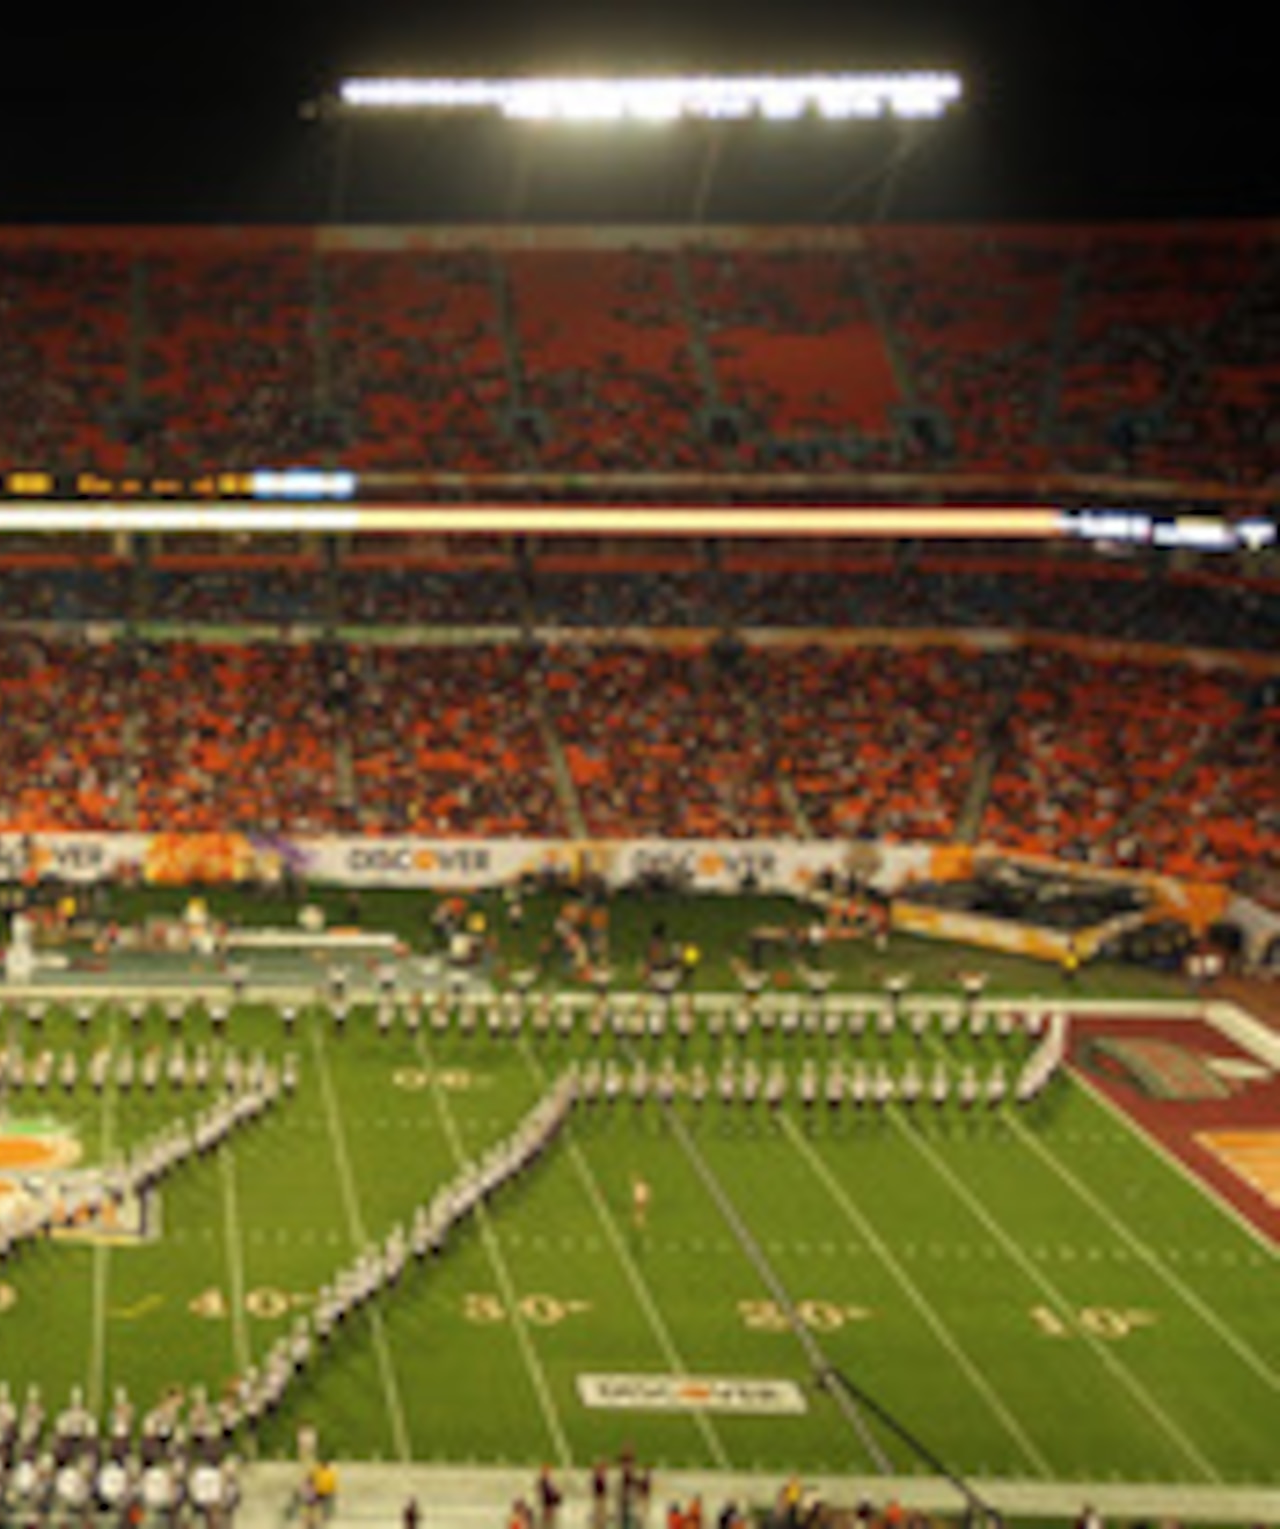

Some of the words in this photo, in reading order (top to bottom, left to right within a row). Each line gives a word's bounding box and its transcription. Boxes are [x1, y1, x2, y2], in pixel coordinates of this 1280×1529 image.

[346, 846, 491, 872] DISCOVER
[188, 1287, 290, 1318] 40
[463, 1293, 566, 1324] 30
[737, 1299, 845, 1332] 20
[1030, 1305, 1132, 1337] 10
